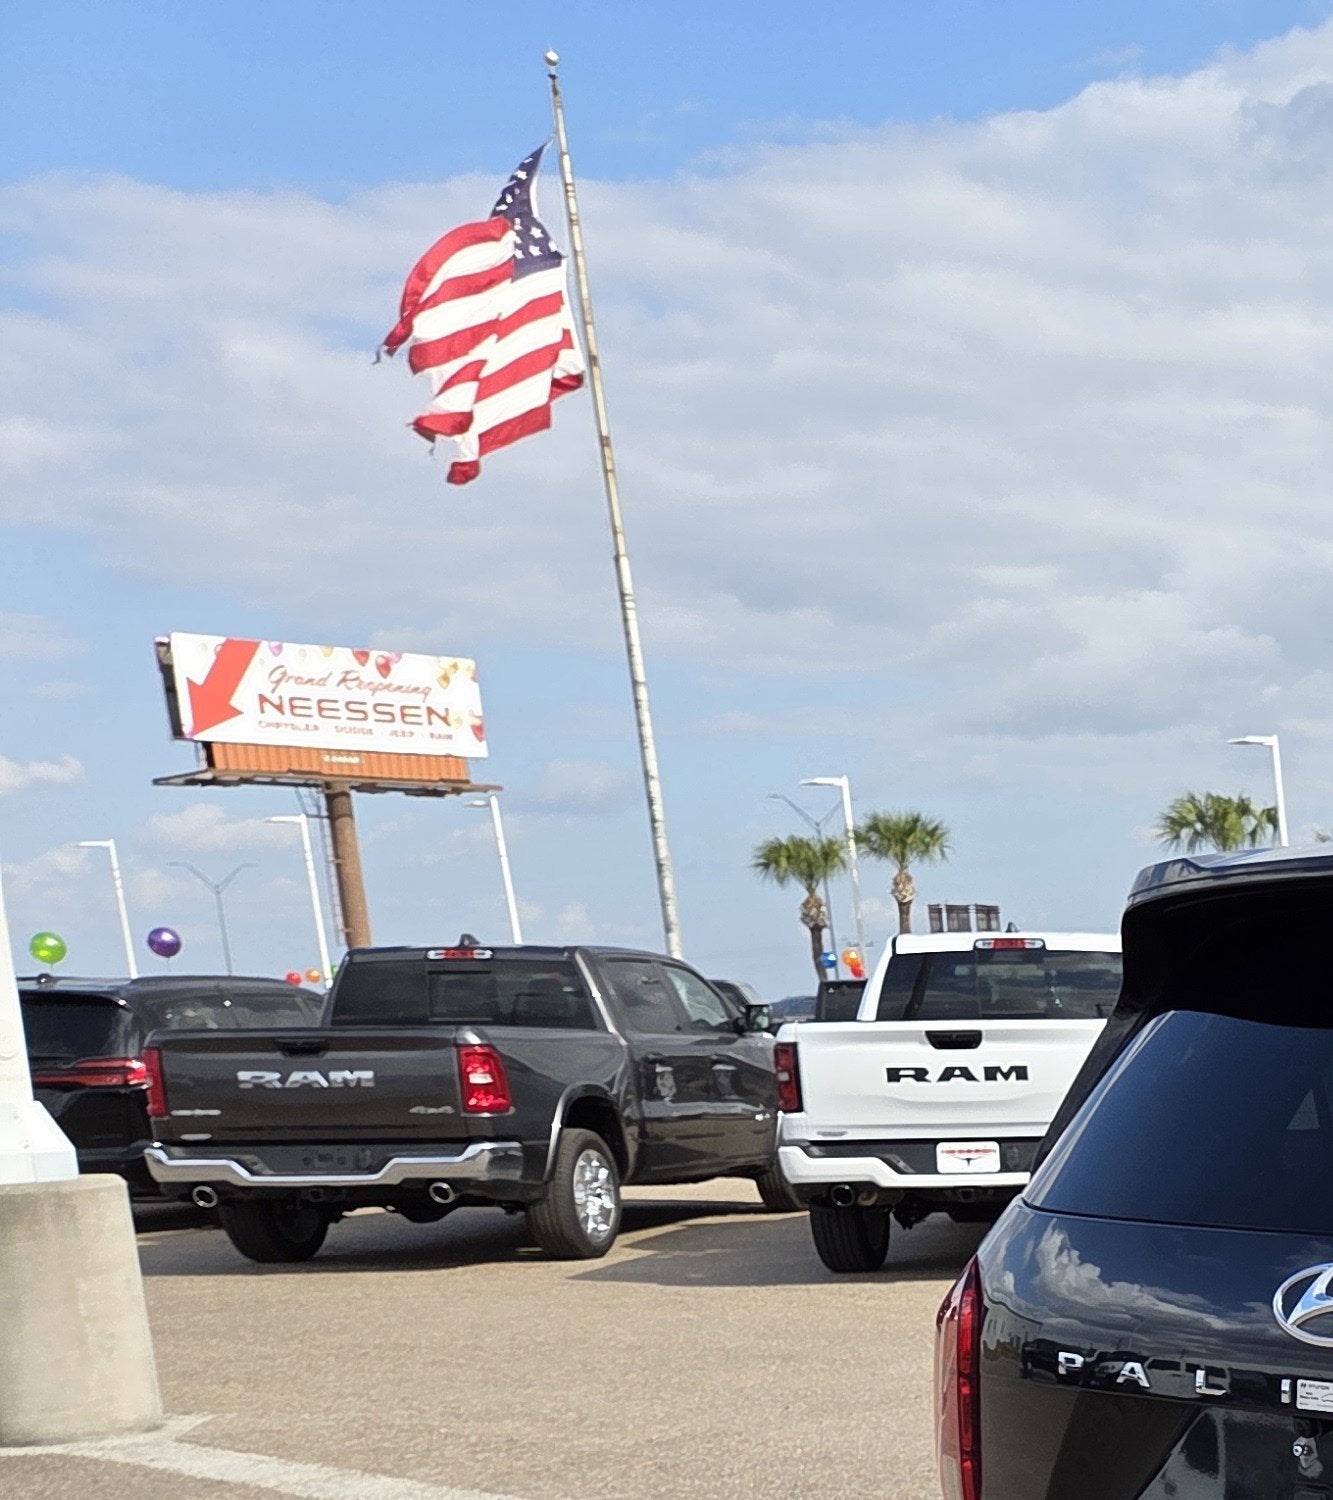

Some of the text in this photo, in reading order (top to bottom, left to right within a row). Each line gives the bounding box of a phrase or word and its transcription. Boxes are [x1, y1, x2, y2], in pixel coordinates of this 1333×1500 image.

[267, 663, 334, 694] Grand
[257, 693, 452, 727] NEESSEN
[236, 1070, 375, 1088] RAM
[885, 1065, 1029, 1083] RAM
